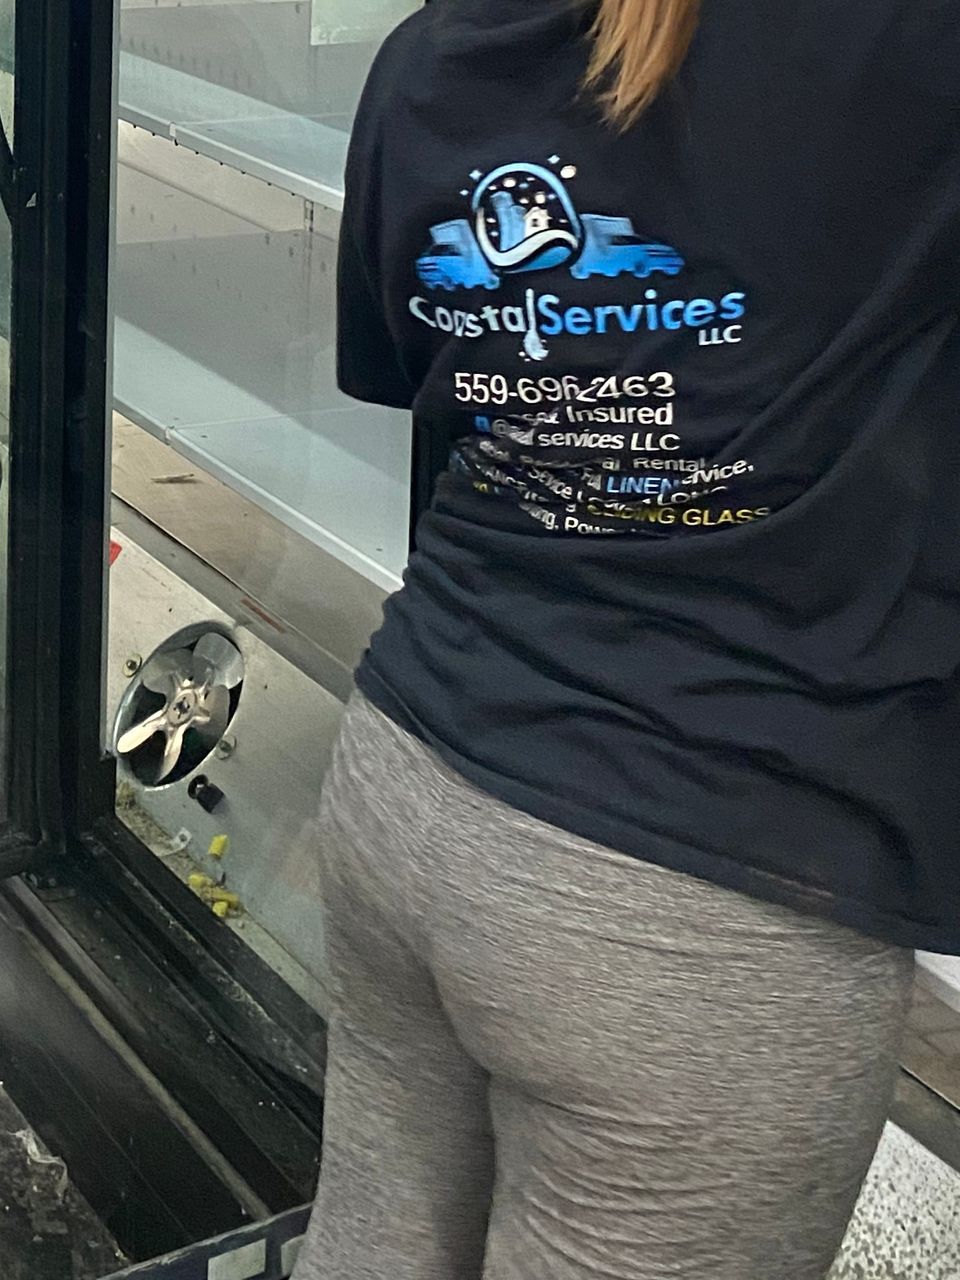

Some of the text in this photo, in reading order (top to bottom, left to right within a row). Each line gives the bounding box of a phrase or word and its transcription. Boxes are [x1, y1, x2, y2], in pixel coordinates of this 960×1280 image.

[540, 288, 746, 336] Services
[698, 324, 743, 347] LLC
[454, 372, 677, 405] 559-6962463
[565, 402, 673, 426] Insured
[537, 429, 626, 450] services
[630, 432, 681, 452] LLC
[607, 476, 681, 496] LINEN
[682, 506, 771, 527] GLASS
